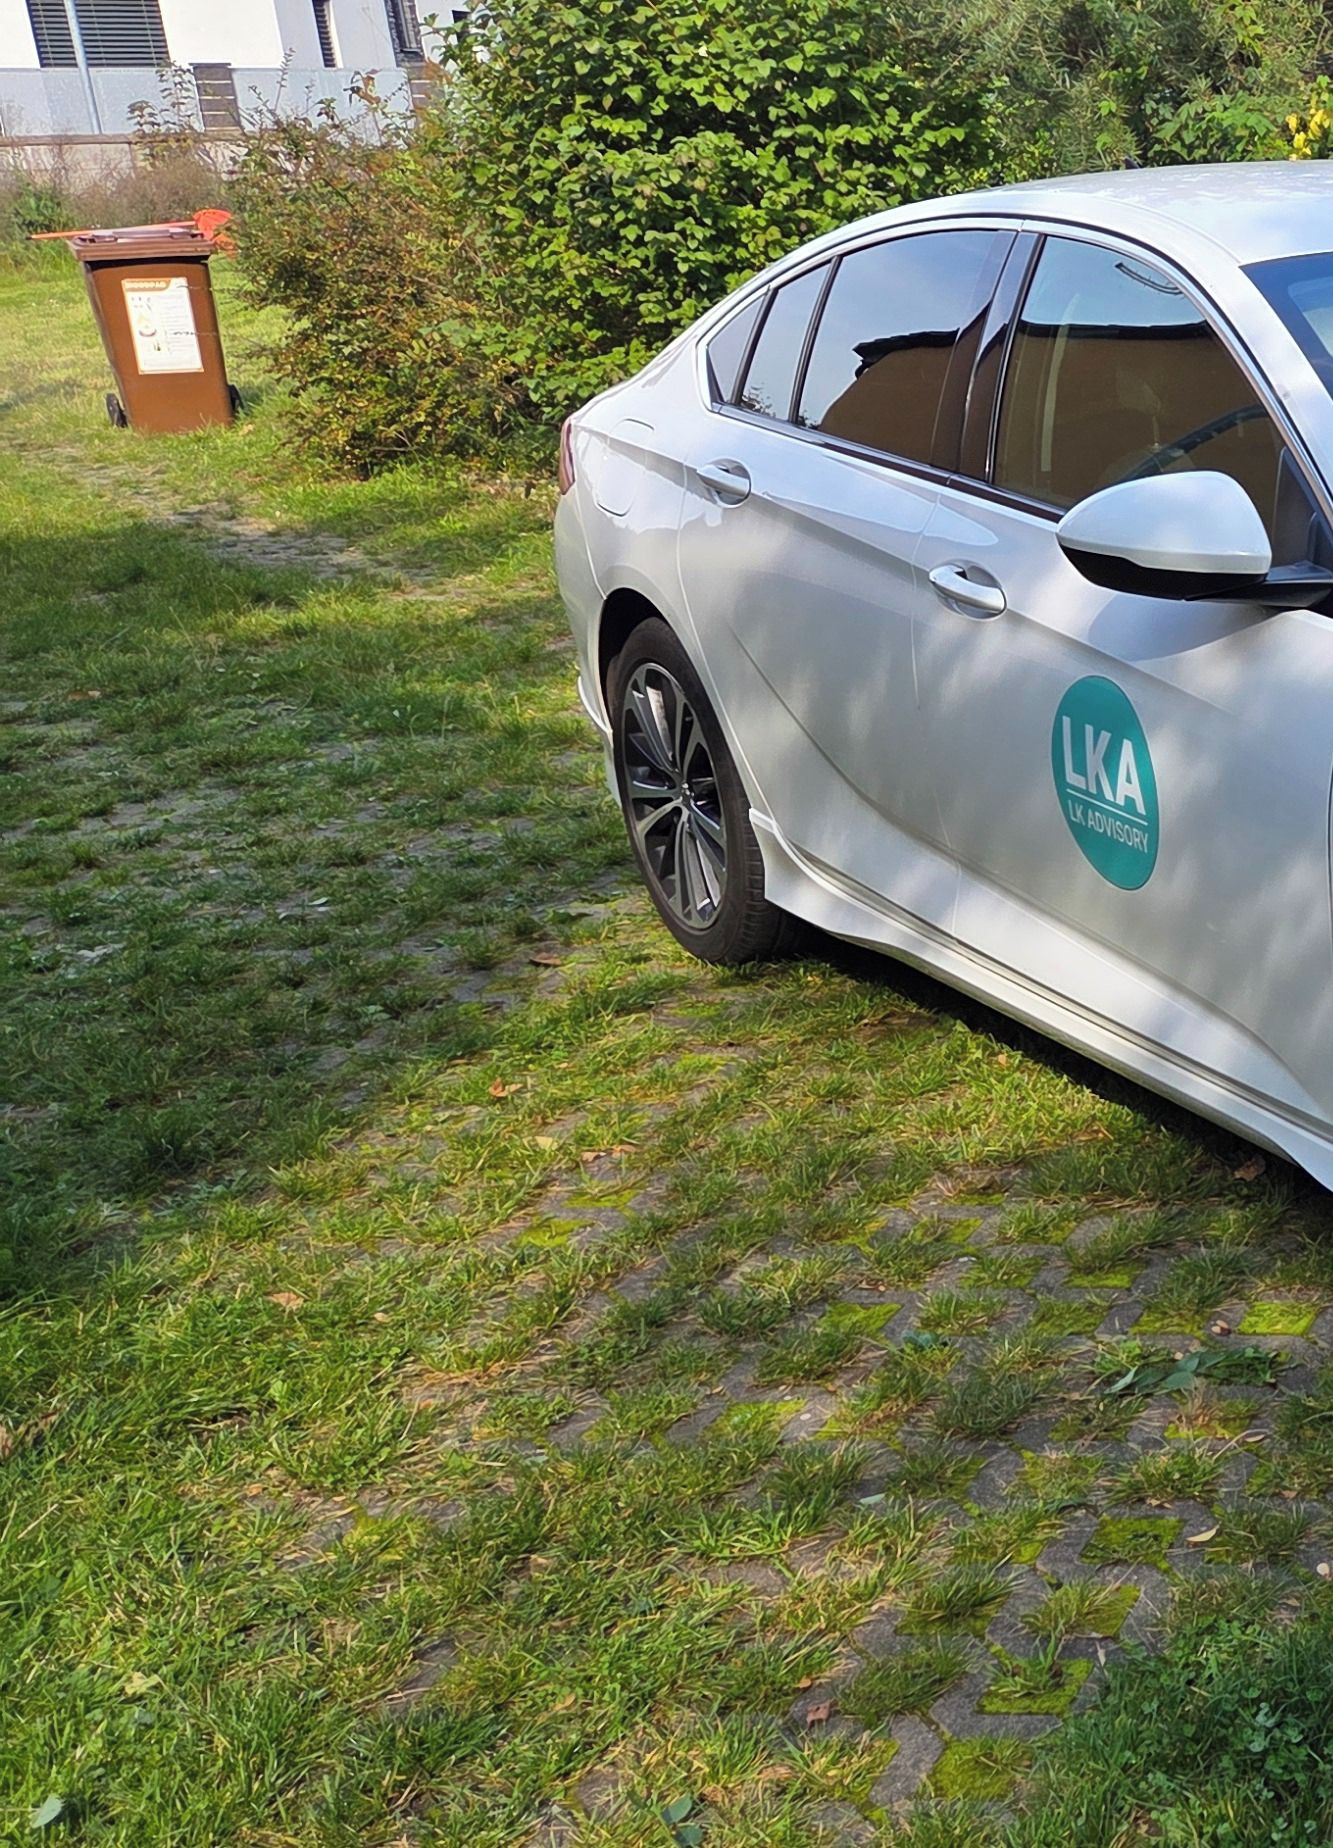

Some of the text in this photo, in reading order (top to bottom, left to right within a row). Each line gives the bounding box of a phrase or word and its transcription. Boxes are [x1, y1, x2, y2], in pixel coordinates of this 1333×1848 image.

[1062, 715, 1146, 816] LKA
[1068, 800, 1148, 854] LK ADVISORY
